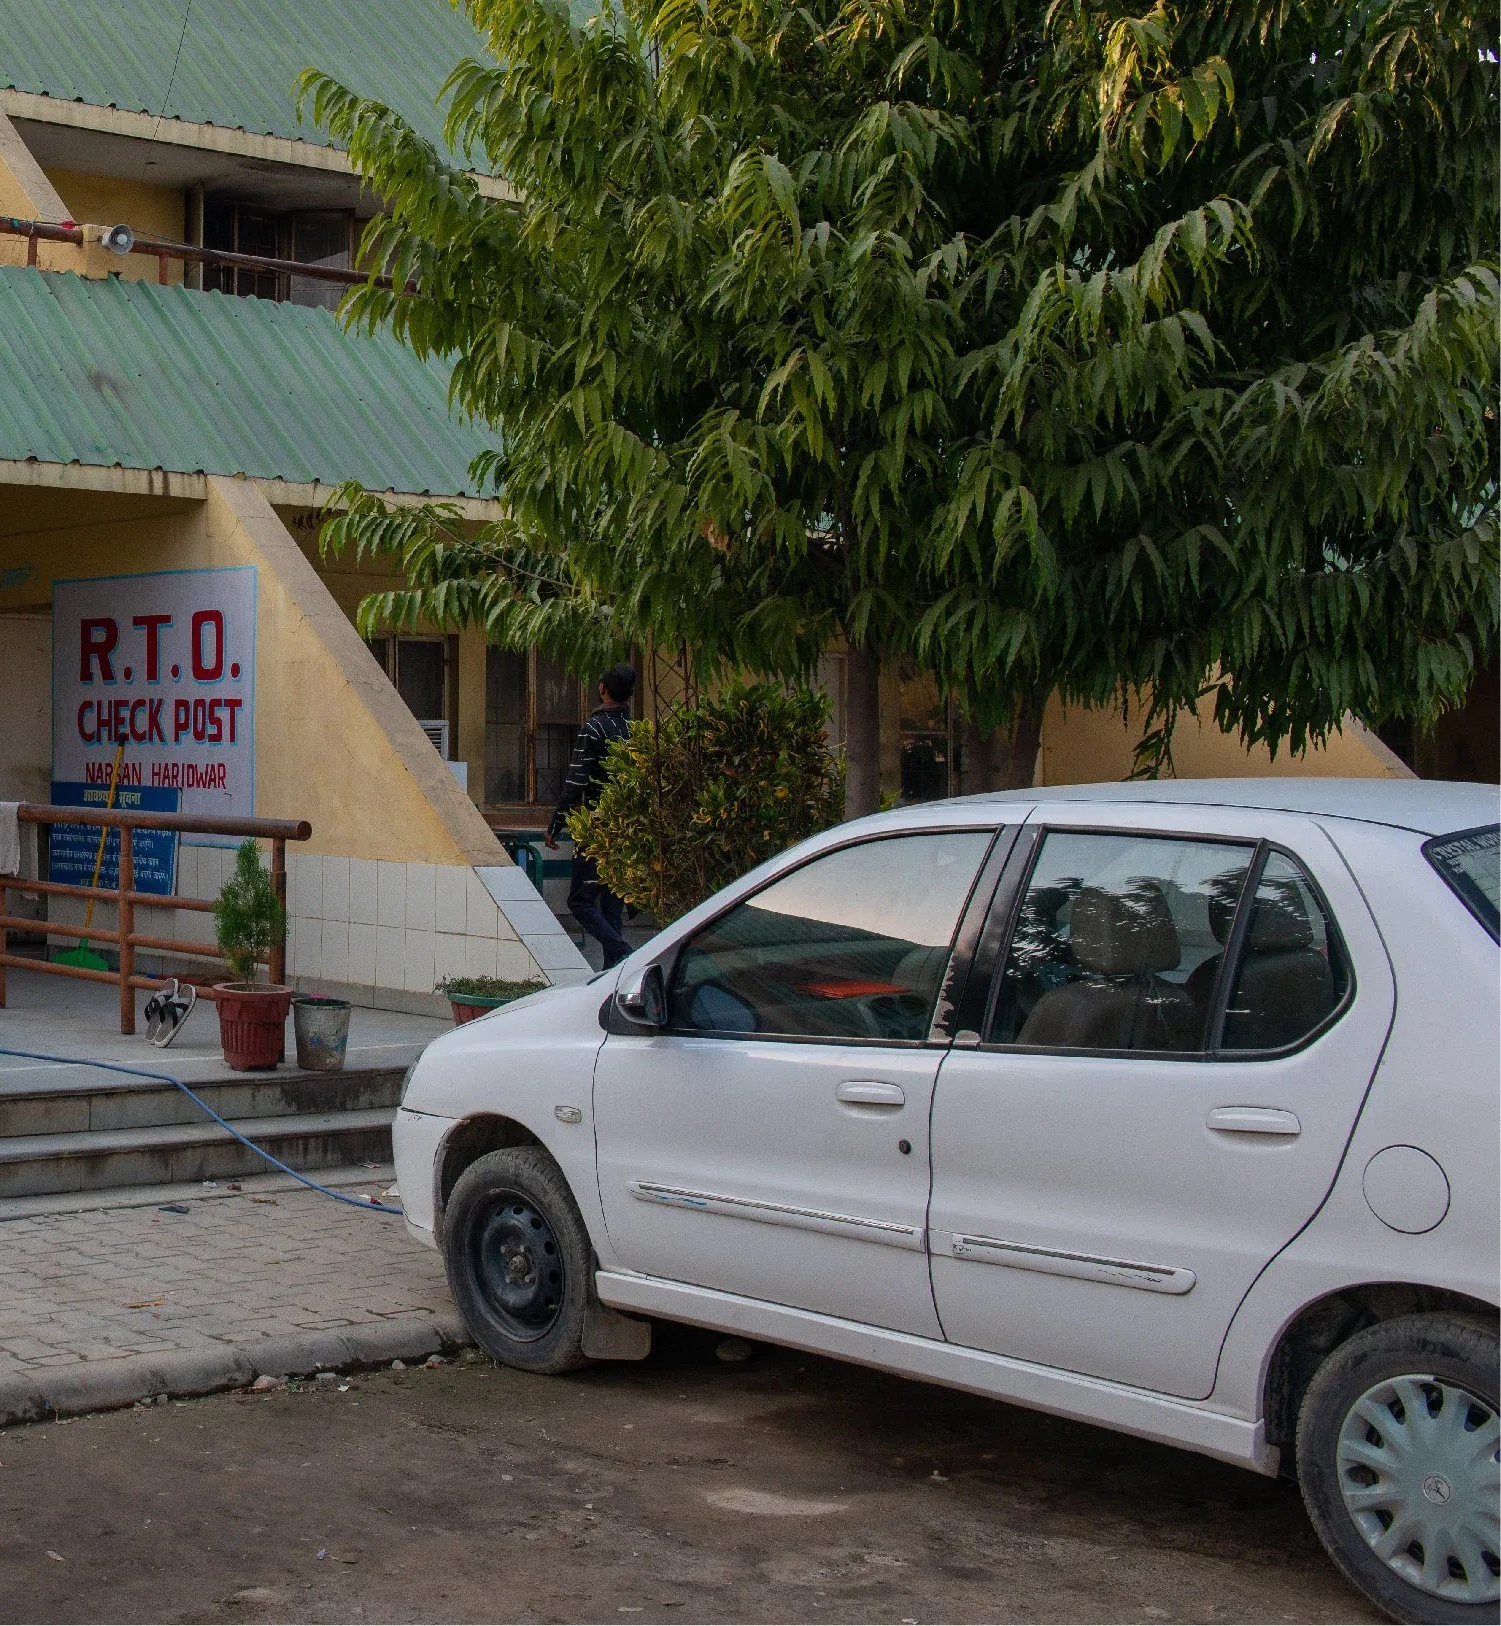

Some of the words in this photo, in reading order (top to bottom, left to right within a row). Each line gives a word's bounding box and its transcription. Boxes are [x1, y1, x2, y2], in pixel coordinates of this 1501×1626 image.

[80, 609, 241, 685] R.T.O.
[77, 698, 165, 744] CHECK
[173, 698, 243, 744] POST
[151, 762, 227, 789] HARIDWAR
[1432, 838, 1481, 860] CRYSTAL
